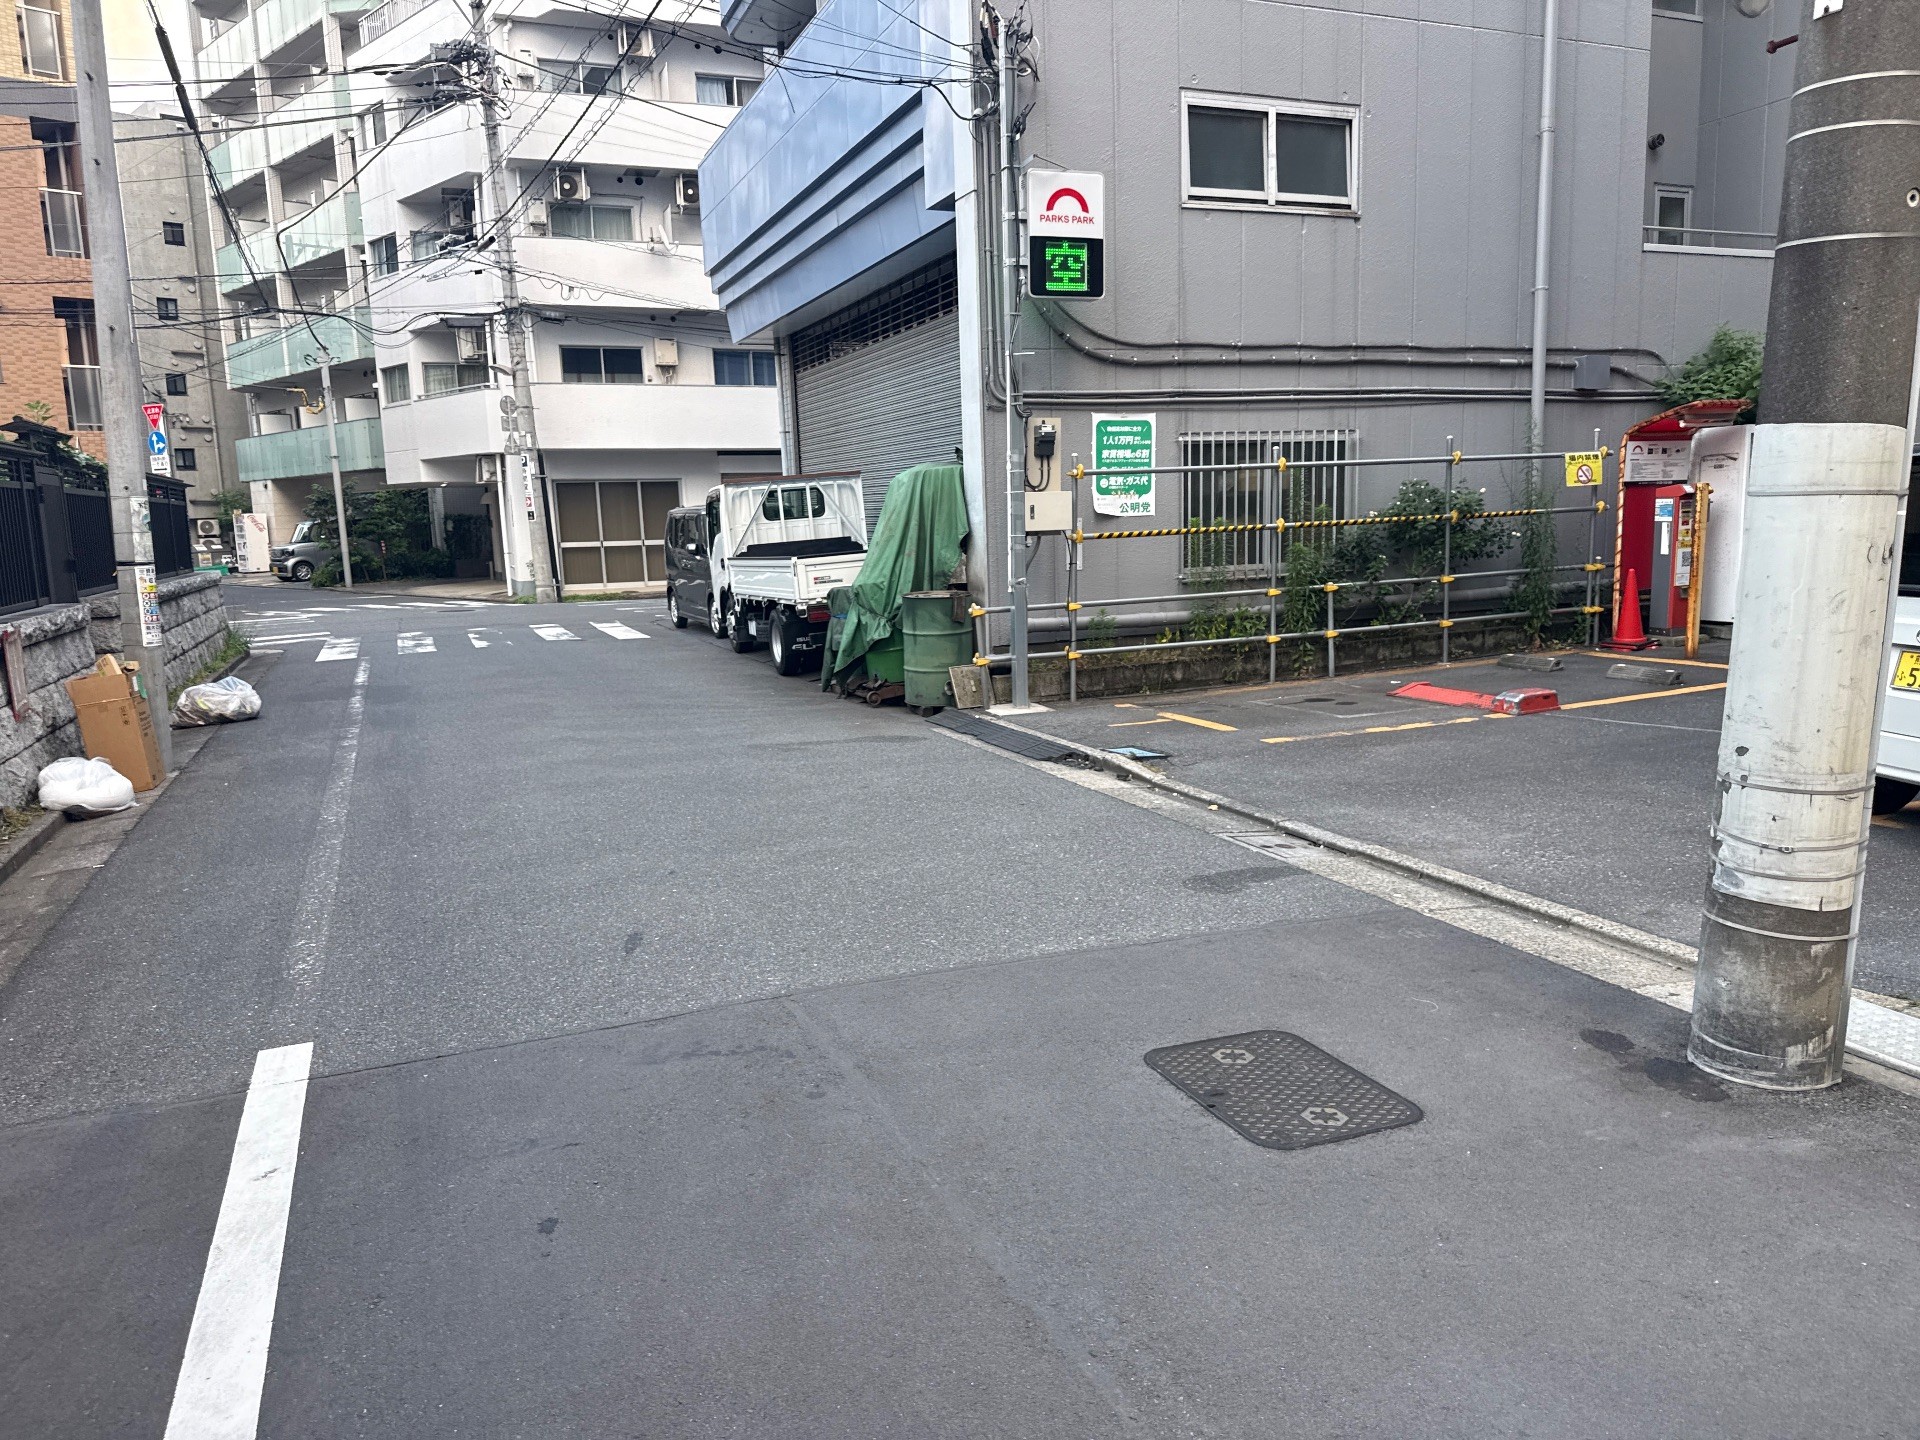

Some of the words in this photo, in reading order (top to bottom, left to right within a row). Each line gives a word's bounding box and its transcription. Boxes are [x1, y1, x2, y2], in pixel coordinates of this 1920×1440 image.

[1039, 214, 1070, 223] PARKS
[1071, 216, 1095, 225] PARK
[1045, 240, 1086, 290] 空
[1103, 435, 1134, 445] 1人1万円
[1119, 502, 1151, 513] 公明党
